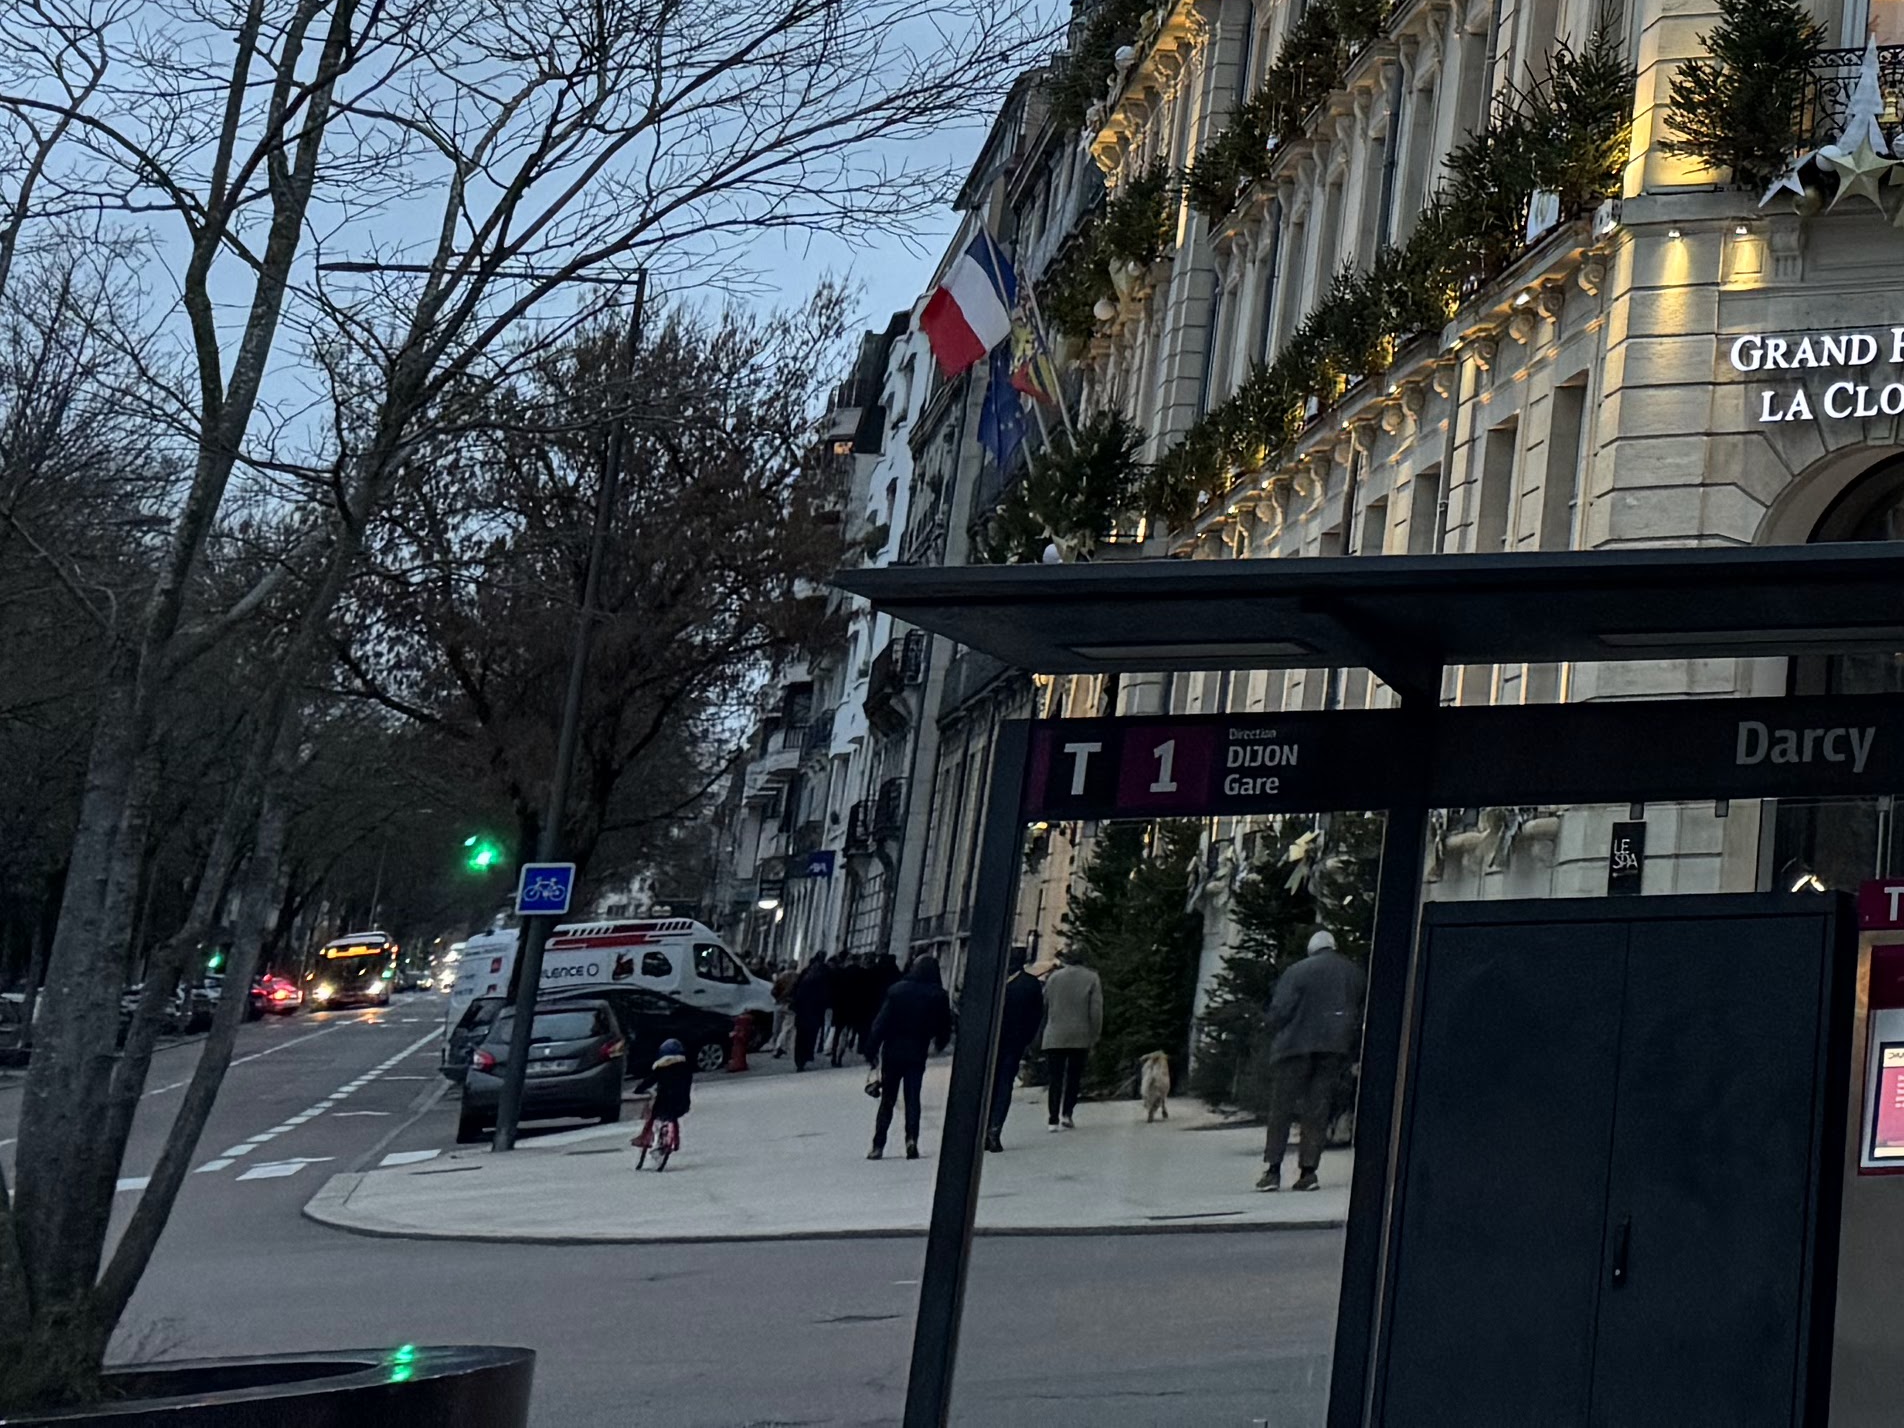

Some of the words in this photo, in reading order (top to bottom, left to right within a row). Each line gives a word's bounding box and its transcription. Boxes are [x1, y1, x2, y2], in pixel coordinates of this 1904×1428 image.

[1228, 727, 1277, 741] Direction
[1735, 719, 1877, 774] Darcy
[1063, 741, 1103, 795] T
[1149, 739, 1178, 793] 1
[1226, 744, 1299, 769] DIJON
[1224, 774, 1280, 796] Gare
[1613, 838, 1631, 855] LE
[1612, 852, 1638, 869] SPA
